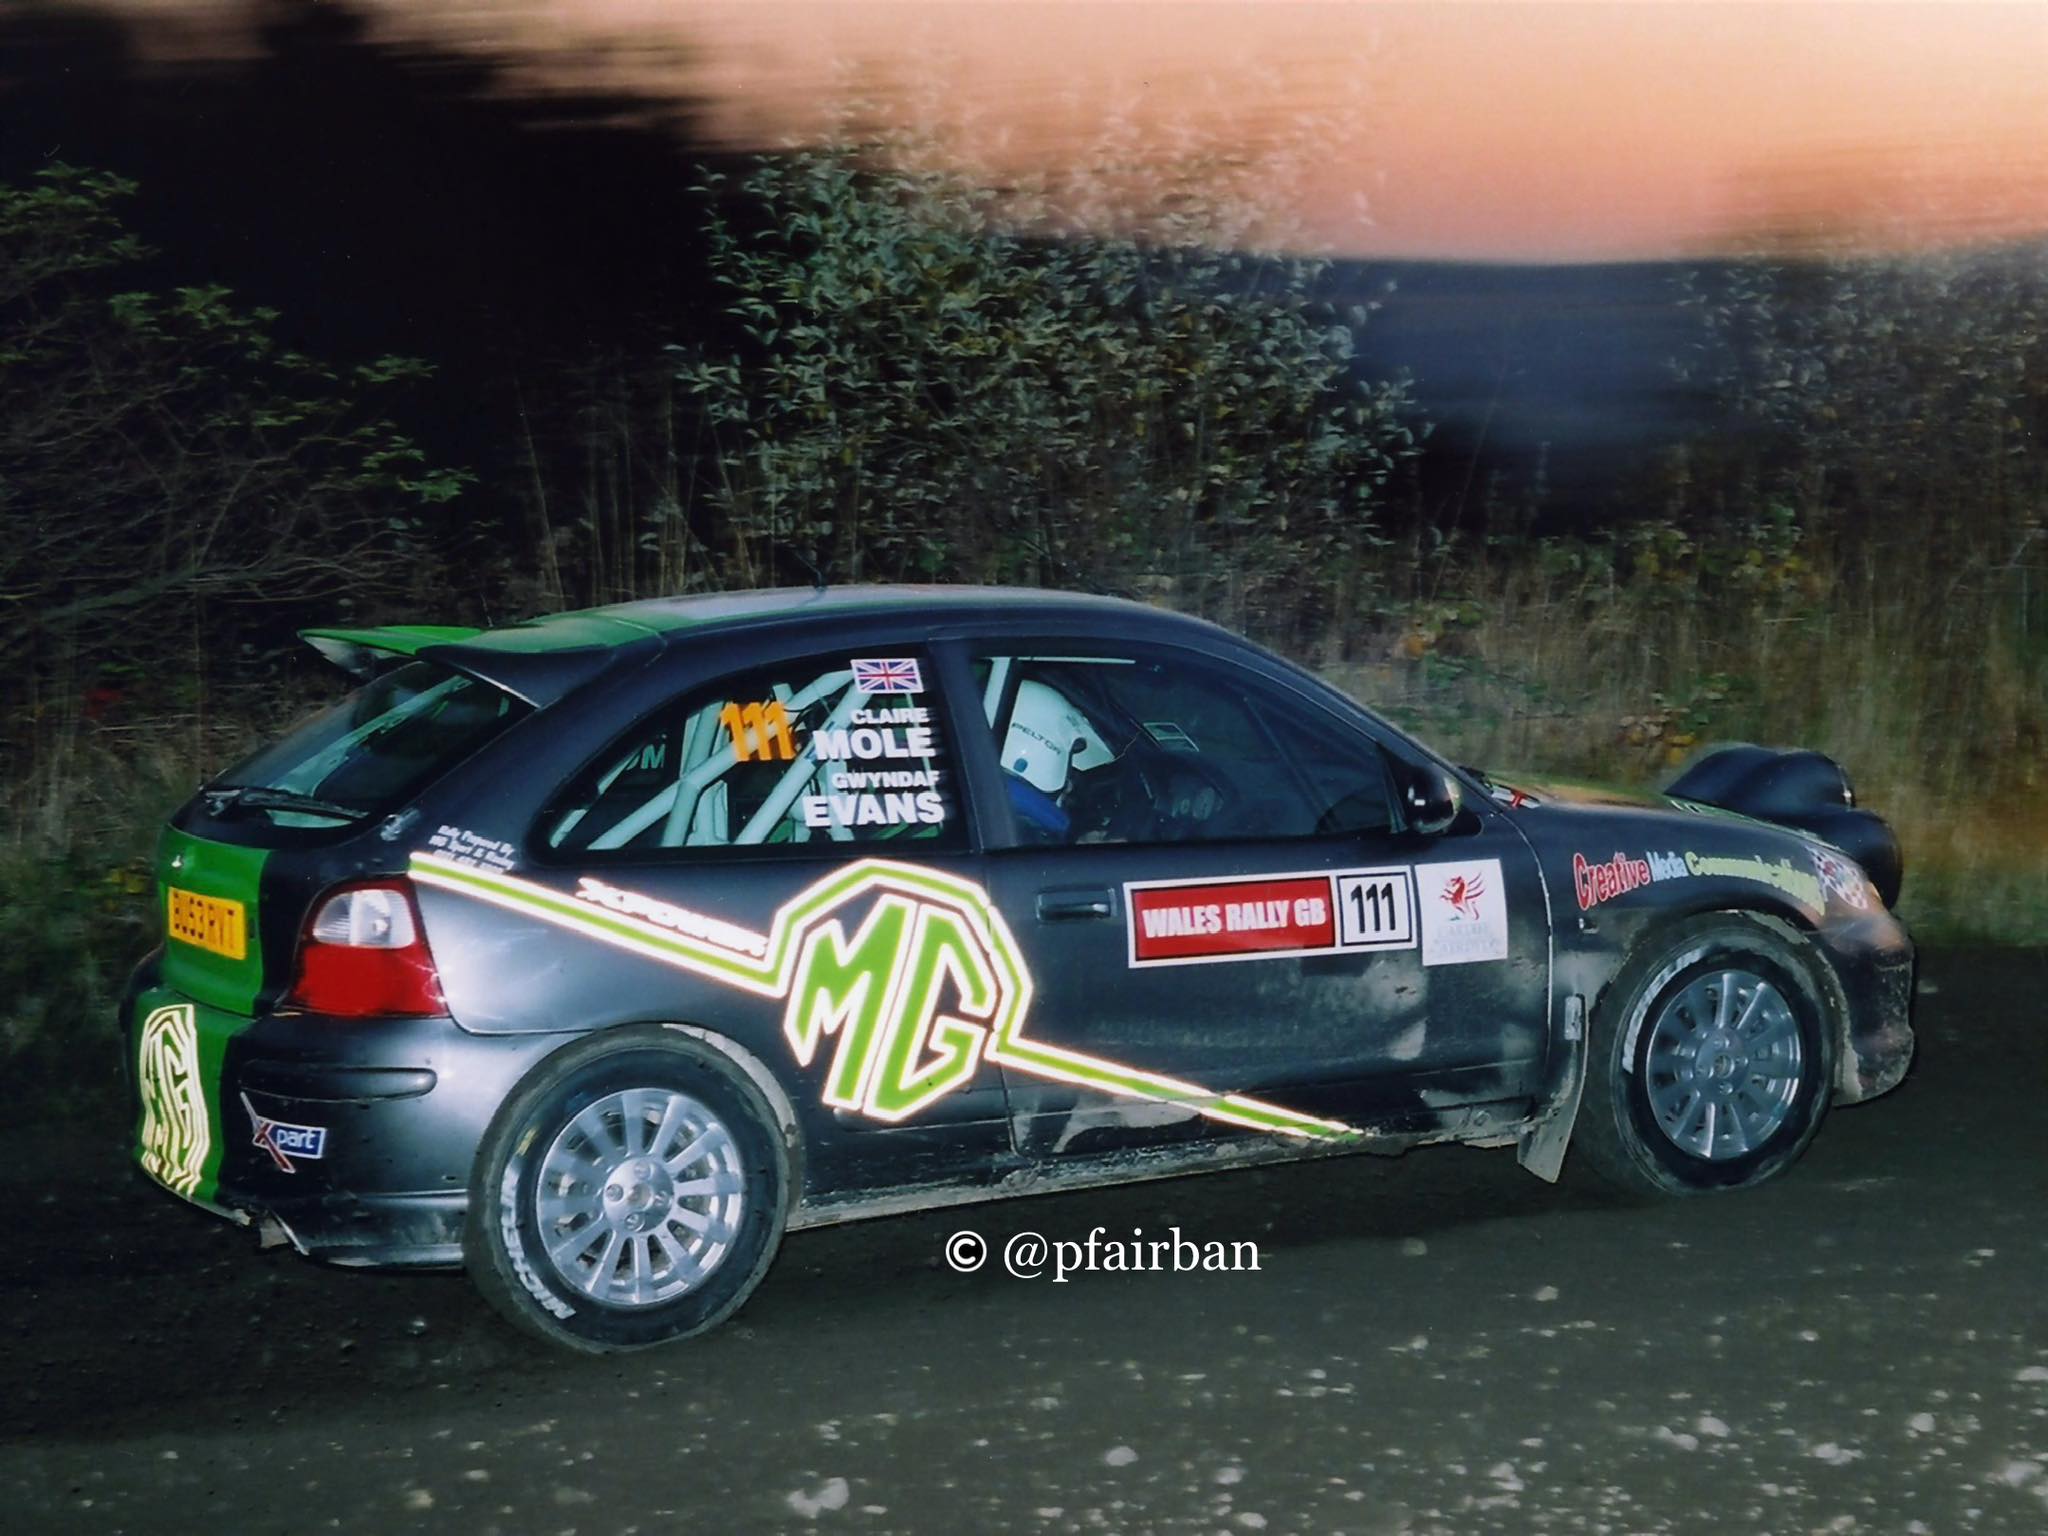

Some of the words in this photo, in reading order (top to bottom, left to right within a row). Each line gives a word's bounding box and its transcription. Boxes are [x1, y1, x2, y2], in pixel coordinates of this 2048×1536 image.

[720, 701, 797, 762] 111
[850, 707, 930, 725] CLAIRE
[813, 727, 937, 760] MOLE
[1010, 721, 1062, 755] PELTOR
[832, 770, 941, 789] GWYNDAF
[802, 792, 946, 828] EVANS
[1573, 852, 1650, 911] Creative
[1142, 905, 1222, 938] WALES
[1225, 900, 1291, 932] RALLY
[1294, 898, 1327, 927] GB
[1350, 882, 1396, 934] 111
[783, 893, 998, 1122] MG
